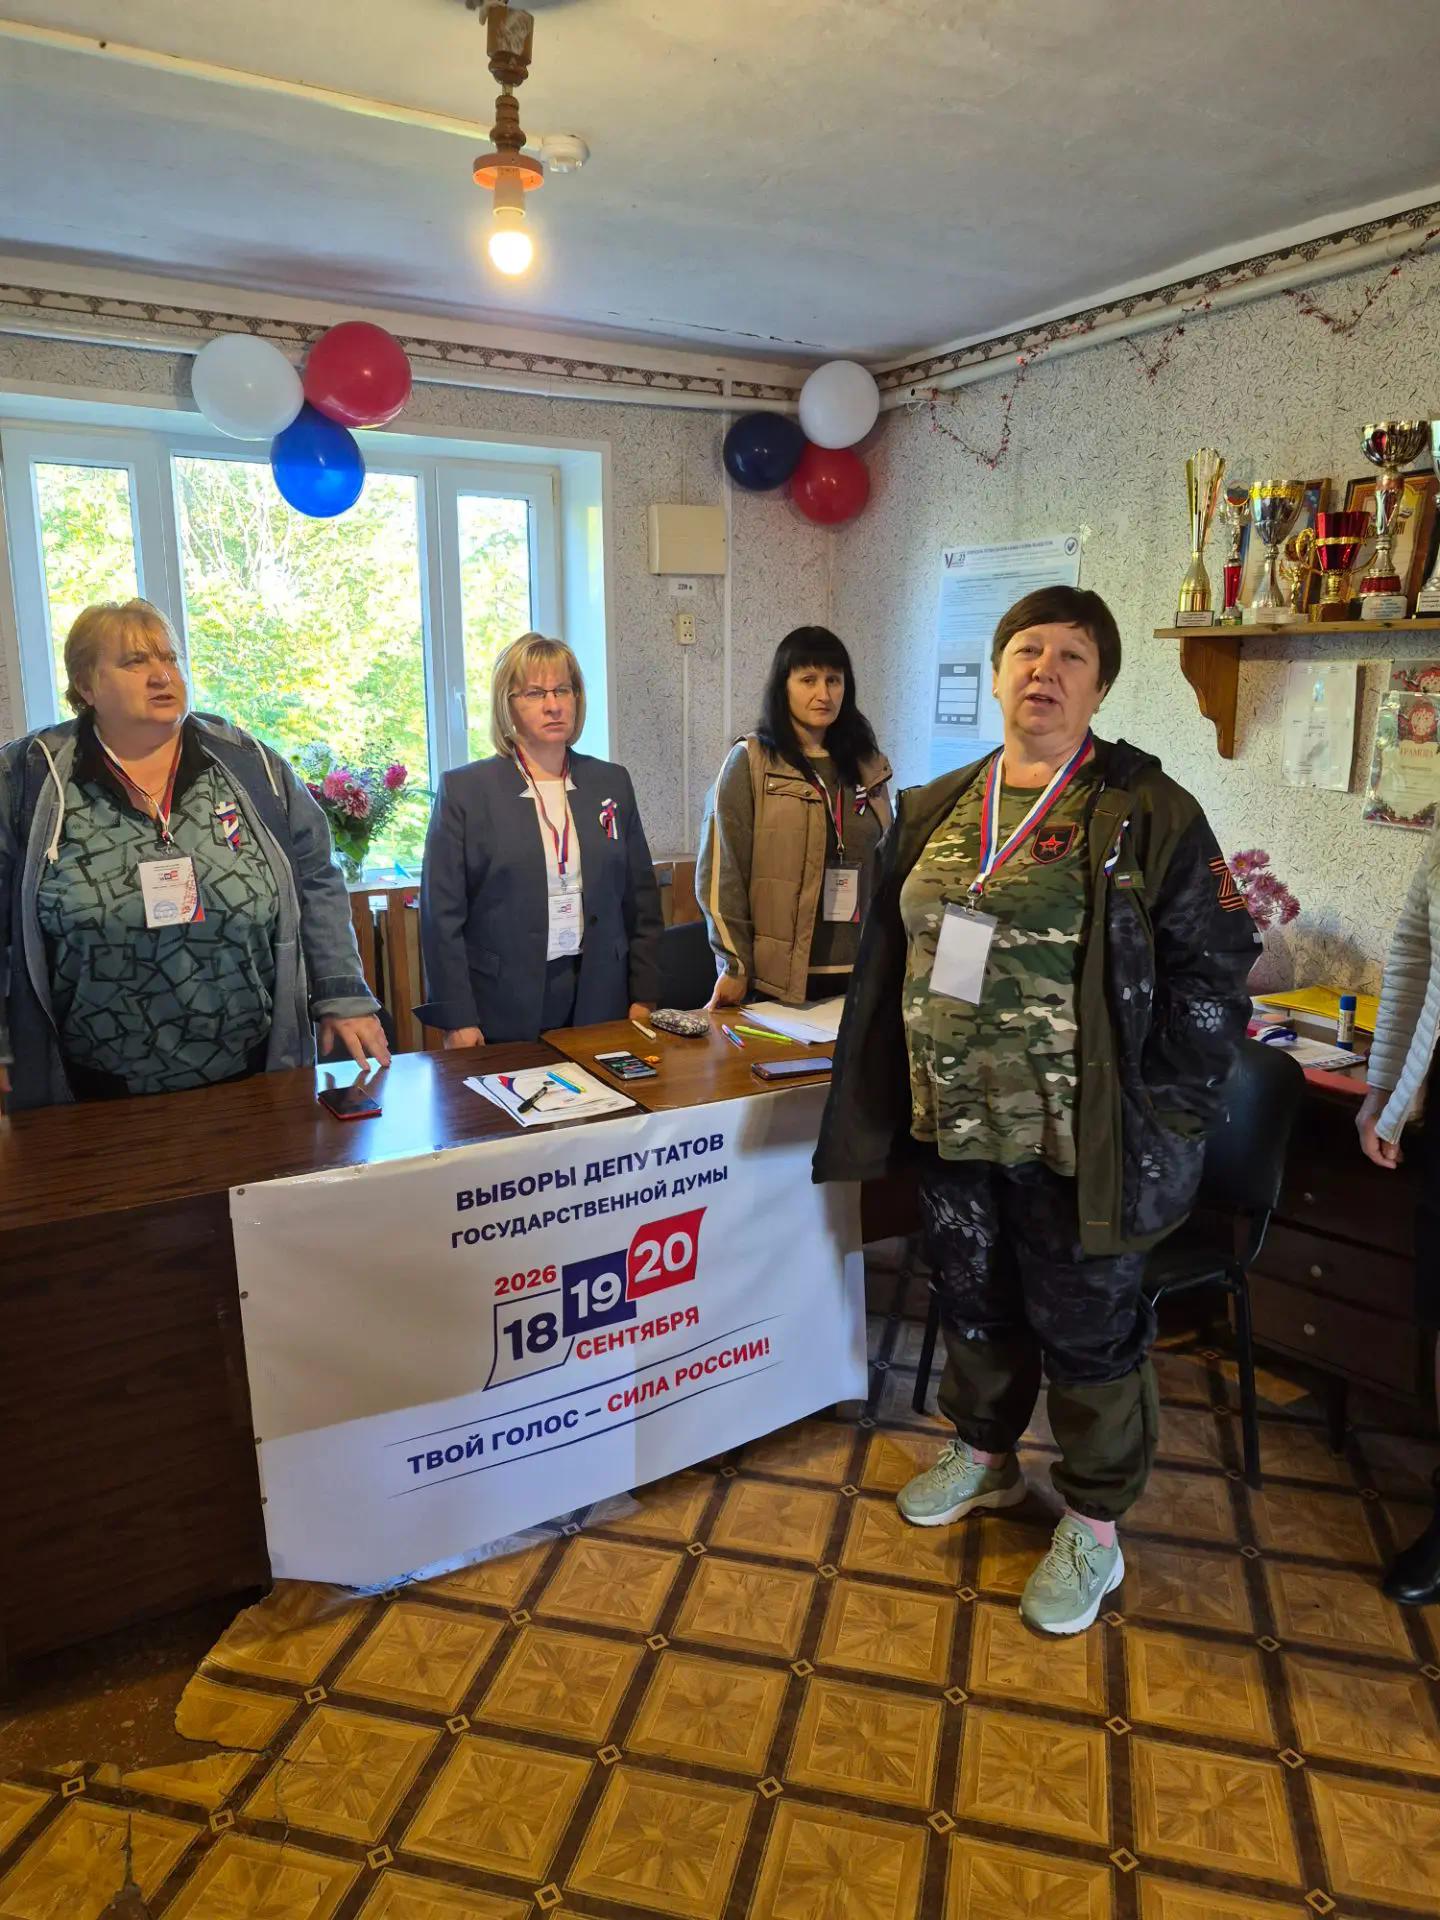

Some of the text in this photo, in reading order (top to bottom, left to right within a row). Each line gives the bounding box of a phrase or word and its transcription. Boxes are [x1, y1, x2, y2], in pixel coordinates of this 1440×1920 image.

[451, 1165, 728, 1248] ГОСУДАРСТВЕННОЙ ДУМЫ
[456, 1133, 724, 1211] ВЫБОРЫ ДЕПУТАТОВ
[494, 1264, 557, 1296] 2026
[503, 1231, 693, 1361] 18 19 20
[575, 1305, 700, 1360] СЕНТЯБРЯ
[407, 1434, 484, 1474] ТВОЙ
[491, 1408, 579, 1451] ГОЛОС
[607, 1375, 670, 1413] СИЛА
[674, 1337, 771, 1387] РОССИИ!
